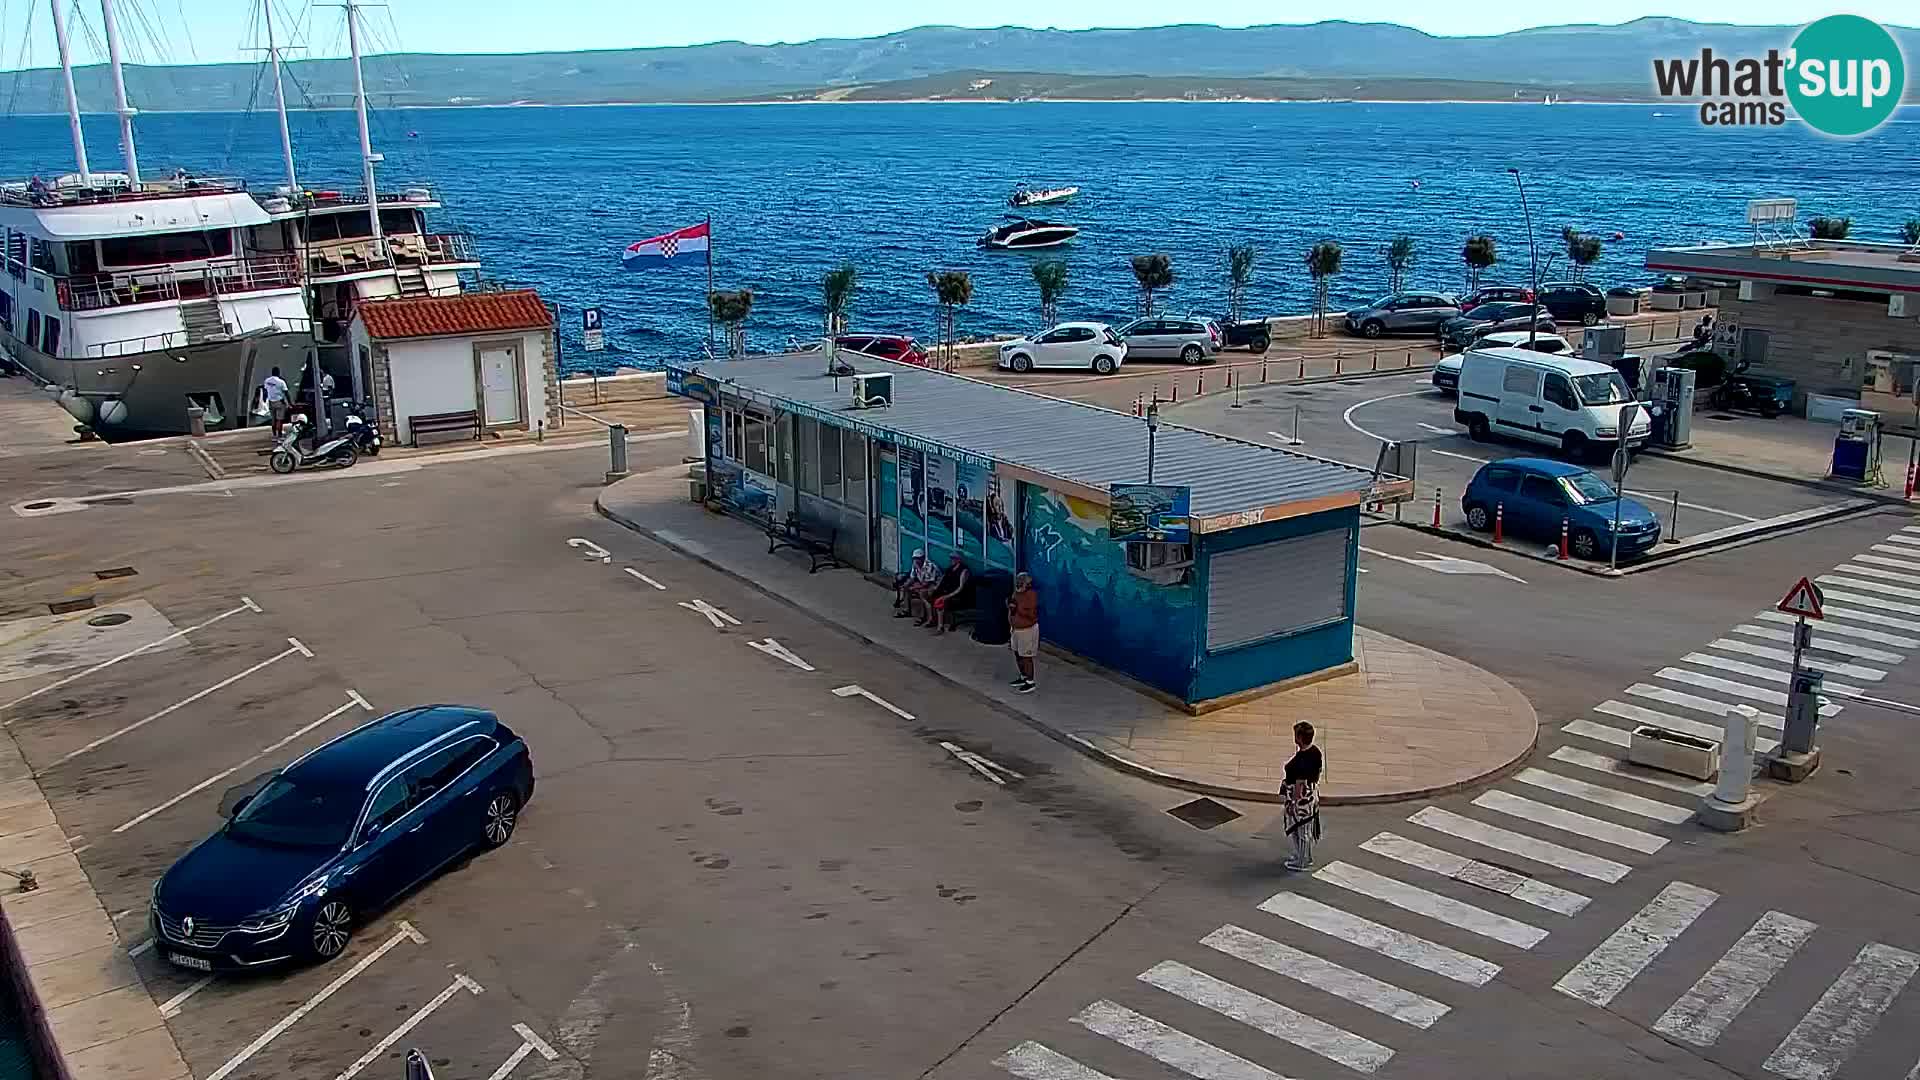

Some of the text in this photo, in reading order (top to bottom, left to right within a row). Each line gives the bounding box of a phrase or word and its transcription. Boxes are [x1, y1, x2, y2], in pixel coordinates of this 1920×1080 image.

[586, 310, 598, 327] P
[893, 433, 908, 446] BUS
[909, 437, 938, 455] STATION
[941, 446, 965, 462] TICKET
[965, 454, 992, 470] OFFICE
